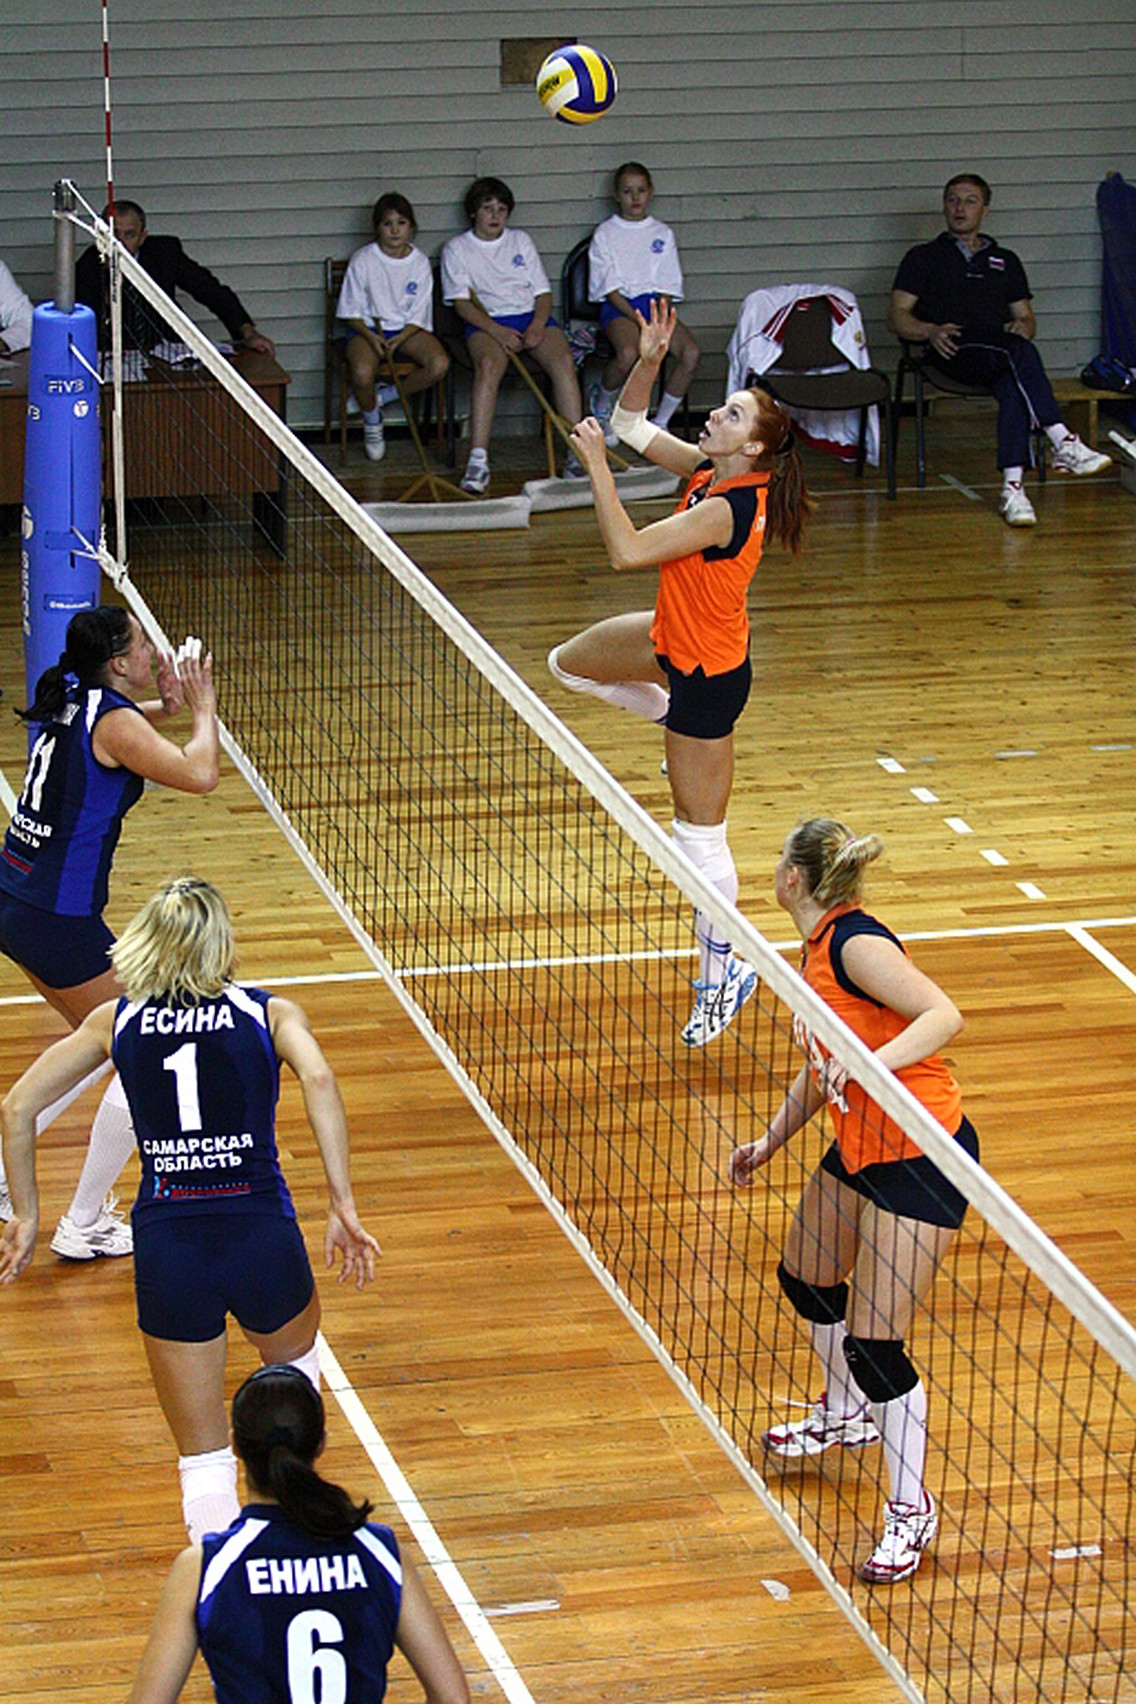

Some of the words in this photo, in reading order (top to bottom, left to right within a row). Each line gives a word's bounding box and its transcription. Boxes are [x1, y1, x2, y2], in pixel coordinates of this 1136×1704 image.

[140, 1004, 235, 1035] ЕСИНА
[163, 1042, 202, 1132] 1
[142, 1133, 254, 1155] САМАРСКАЯ
[153, 1152, 242, 1173] ОБЛАСТЬ
[246, 1554, 369, 1595] ЕНИНА
[287, 1608, 347, 1704] 6
